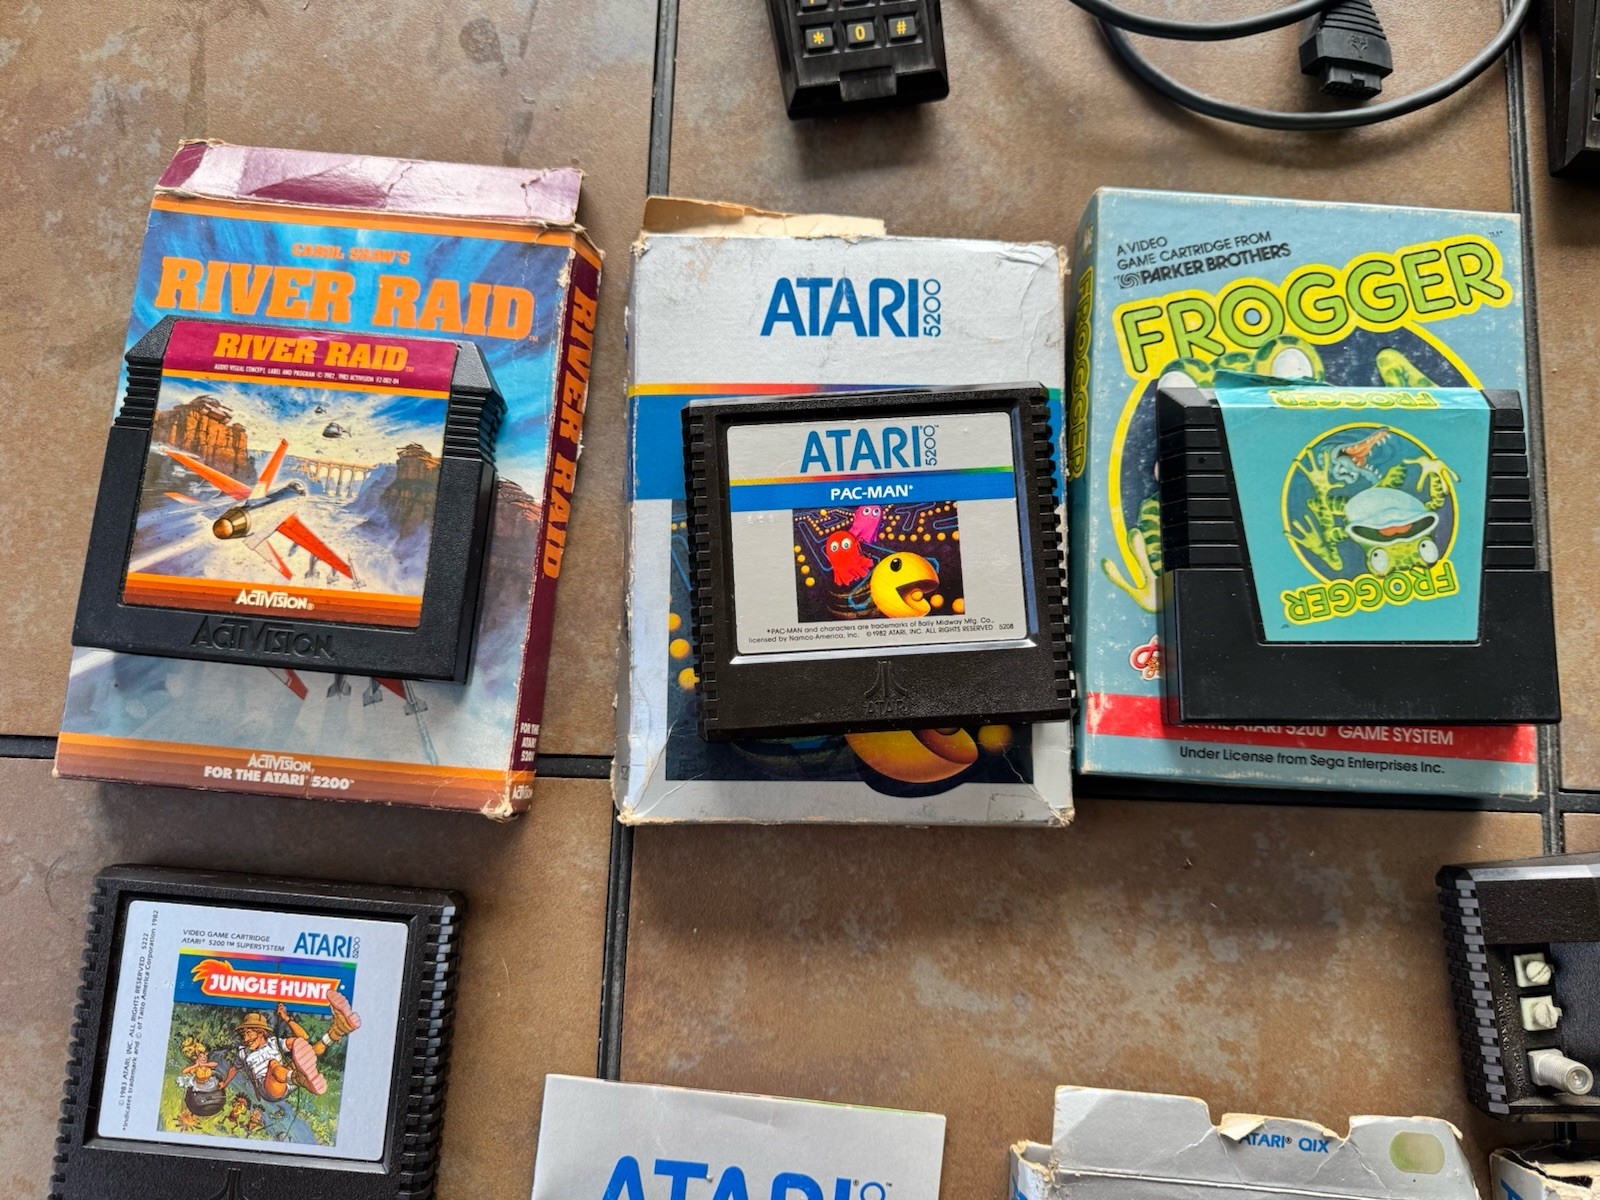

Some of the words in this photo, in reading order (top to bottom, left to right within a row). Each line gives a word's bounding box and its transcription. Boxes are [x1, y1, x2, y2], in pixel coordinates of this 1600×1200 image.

[854, 25, 866, 41] 0
[896, 20, 907, 35] #
[291, 243, 344, 260] CAROL
[348, 248, 411, 265] SHAW'S
[1116, 245, 1126, 256] A
[1126, 236, 1168, 253] VIDEO
[1117, 253, 1156, 270] GAME
[1159, 238, 1231, 261] CARTRIDGE
[1234, 231, 1272, 248] FROM
[1140, 261, 1205, 286] PARKER
[1205, 243, 1291, 272] BROTHERS
[154, 257, 355, 324] RIVER
[760, 277, 919, 337] ATARI
[923, 278, 941, 337] 5200
[1118, 240, 1507, 375] FROGGER
[213, 332, 318, 364] RIVER
[214, 363, 229, 371] AUDIO
[267, 367, 282, 375] LABEL
[282, 368, 292, 376] AND
[293, 369, 315, 378] PROGRAM
[559, 286, 597, 447] RIVER
[1068, 265, 1094, 482] FROGGER
[1268, 390, 1439, 409] FROGGER
[800, 426, 921, 473] ATARI
[923, 425, 938, 466] 5200
[543, 452, 576, 579] RAID
[1283, 561, 1457, 622] FROGGER
[819, 624, 856, 632] characters
[870, 620, 908, 629] trademarks
[918, 619, 934, 628] Bally
[936, 618, 962, 627] Midway
[964, 617, 977, 625] Mfg.
[938, 625, 961, 633] RIGHTS
[962, 624, 993, 632] RESERVED
[1337, 726, 1389, 742] GAME
[1392, 728, 1454, 746] SYSTEM
[1180, 746, 1221, 760] Under
[1223, 748, 1274, 764] License
[1277, 750, 1307, 766] from
[1310, 754, 1345, 770] Sega
[1348, 757, 1418, 774] Enterprises
[1420, 761, 1446, 774] Inc.
[204, 765, 232, 780] FOR
[235, 768, 261, 782] THE
[151, 910, 159, 926] 1982
[141, 932, 149, 950] 5222
[145, 928, 156, 970] Corporation
[182, 929, 206, 937] VIDEO
[207, 931, 229, 939] GAME
[231, 933, 270, 943] CARTRIDGE
[236, 942, 285, 952] SUPERSYSTEM
[293, 931, 352, 959] ATARI
[353, 936, 361, 959] 5200
[135, 956, 146, 994] RESERVED
[141, 971, 150, 1000] America
[209, 973, 278, 995] JUNGLE
[280, 981, 332, 999] HUNT
[131, 996, 140, 1022] RIGHTS
[138, 1001, 146, 1020] Taito
[138, 1022, 143, 1030] of
[128, 1057, 137, 1093] trademark
[1298, 1138, 1330, 1153] QIX
